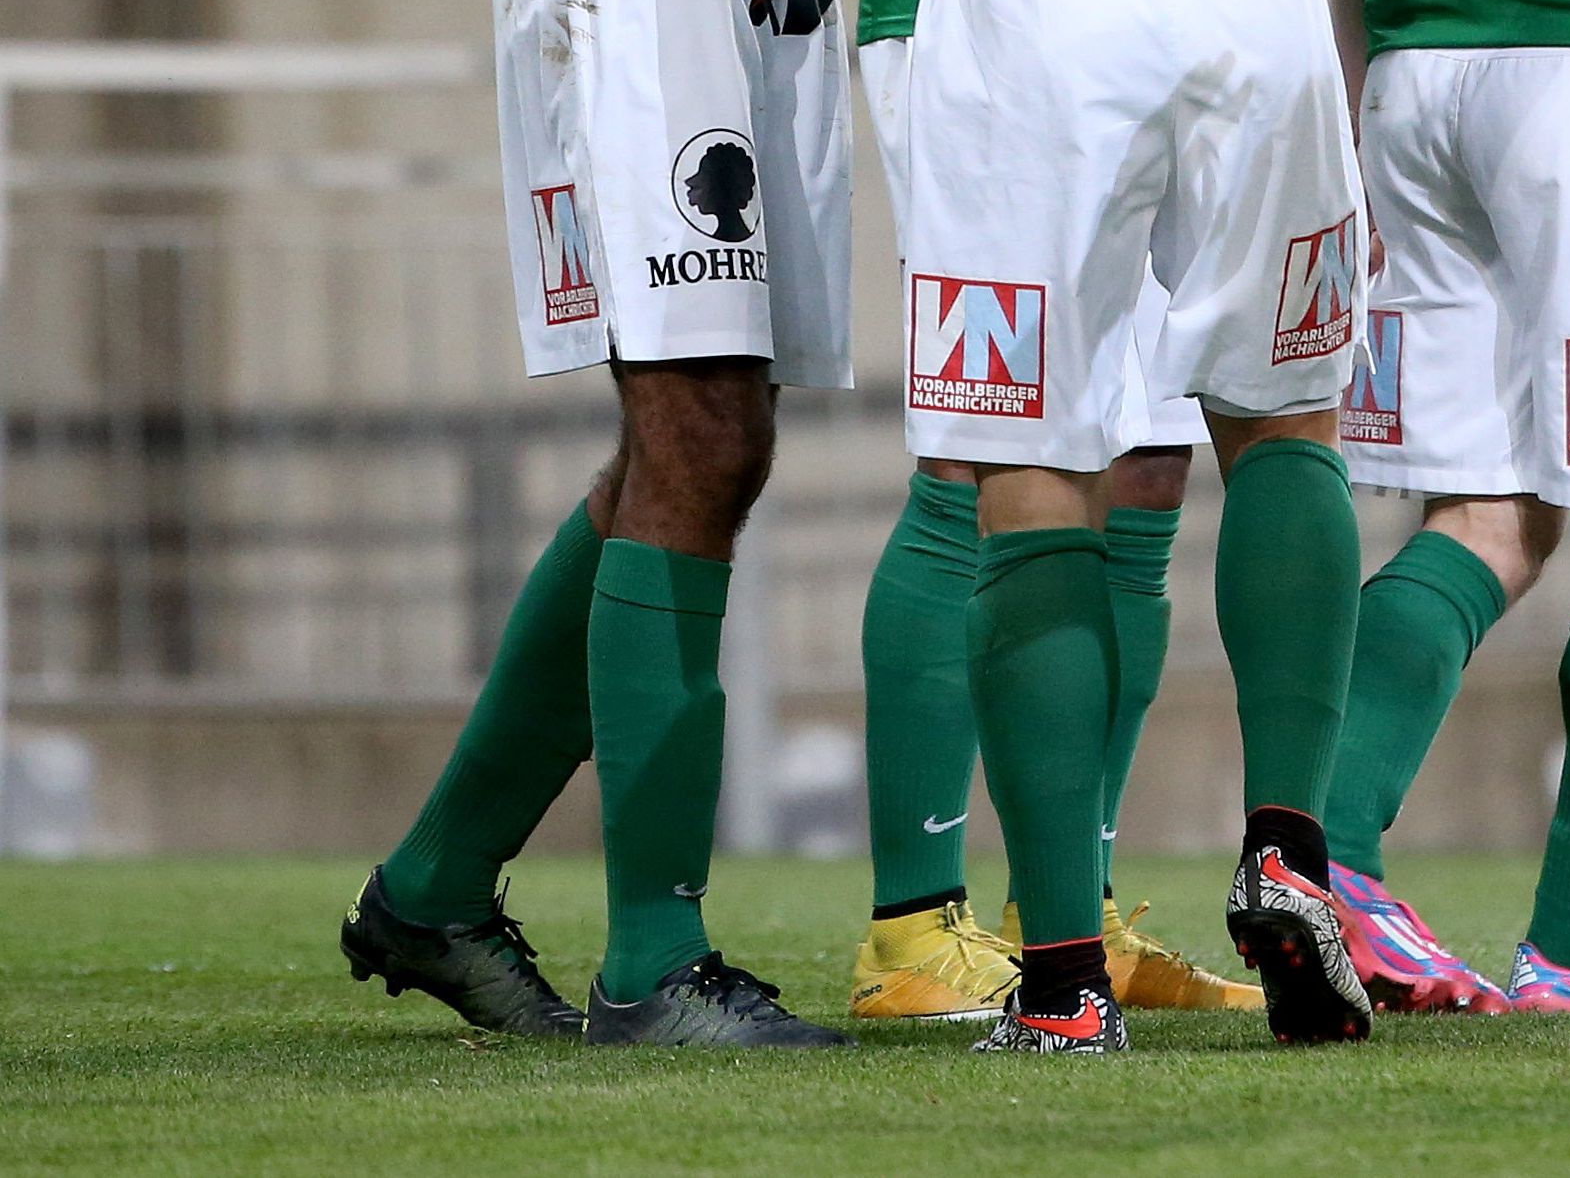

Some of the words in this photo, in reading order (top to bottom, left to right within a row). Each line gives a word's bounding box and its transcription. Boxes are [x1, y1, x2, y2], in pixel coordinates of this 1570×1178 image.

[914, 279, 1042, 385] VN
[912, 376, 1039, 401] VORARLBERGER
[912, 391, 1025, 414] NACHRICHTEN
